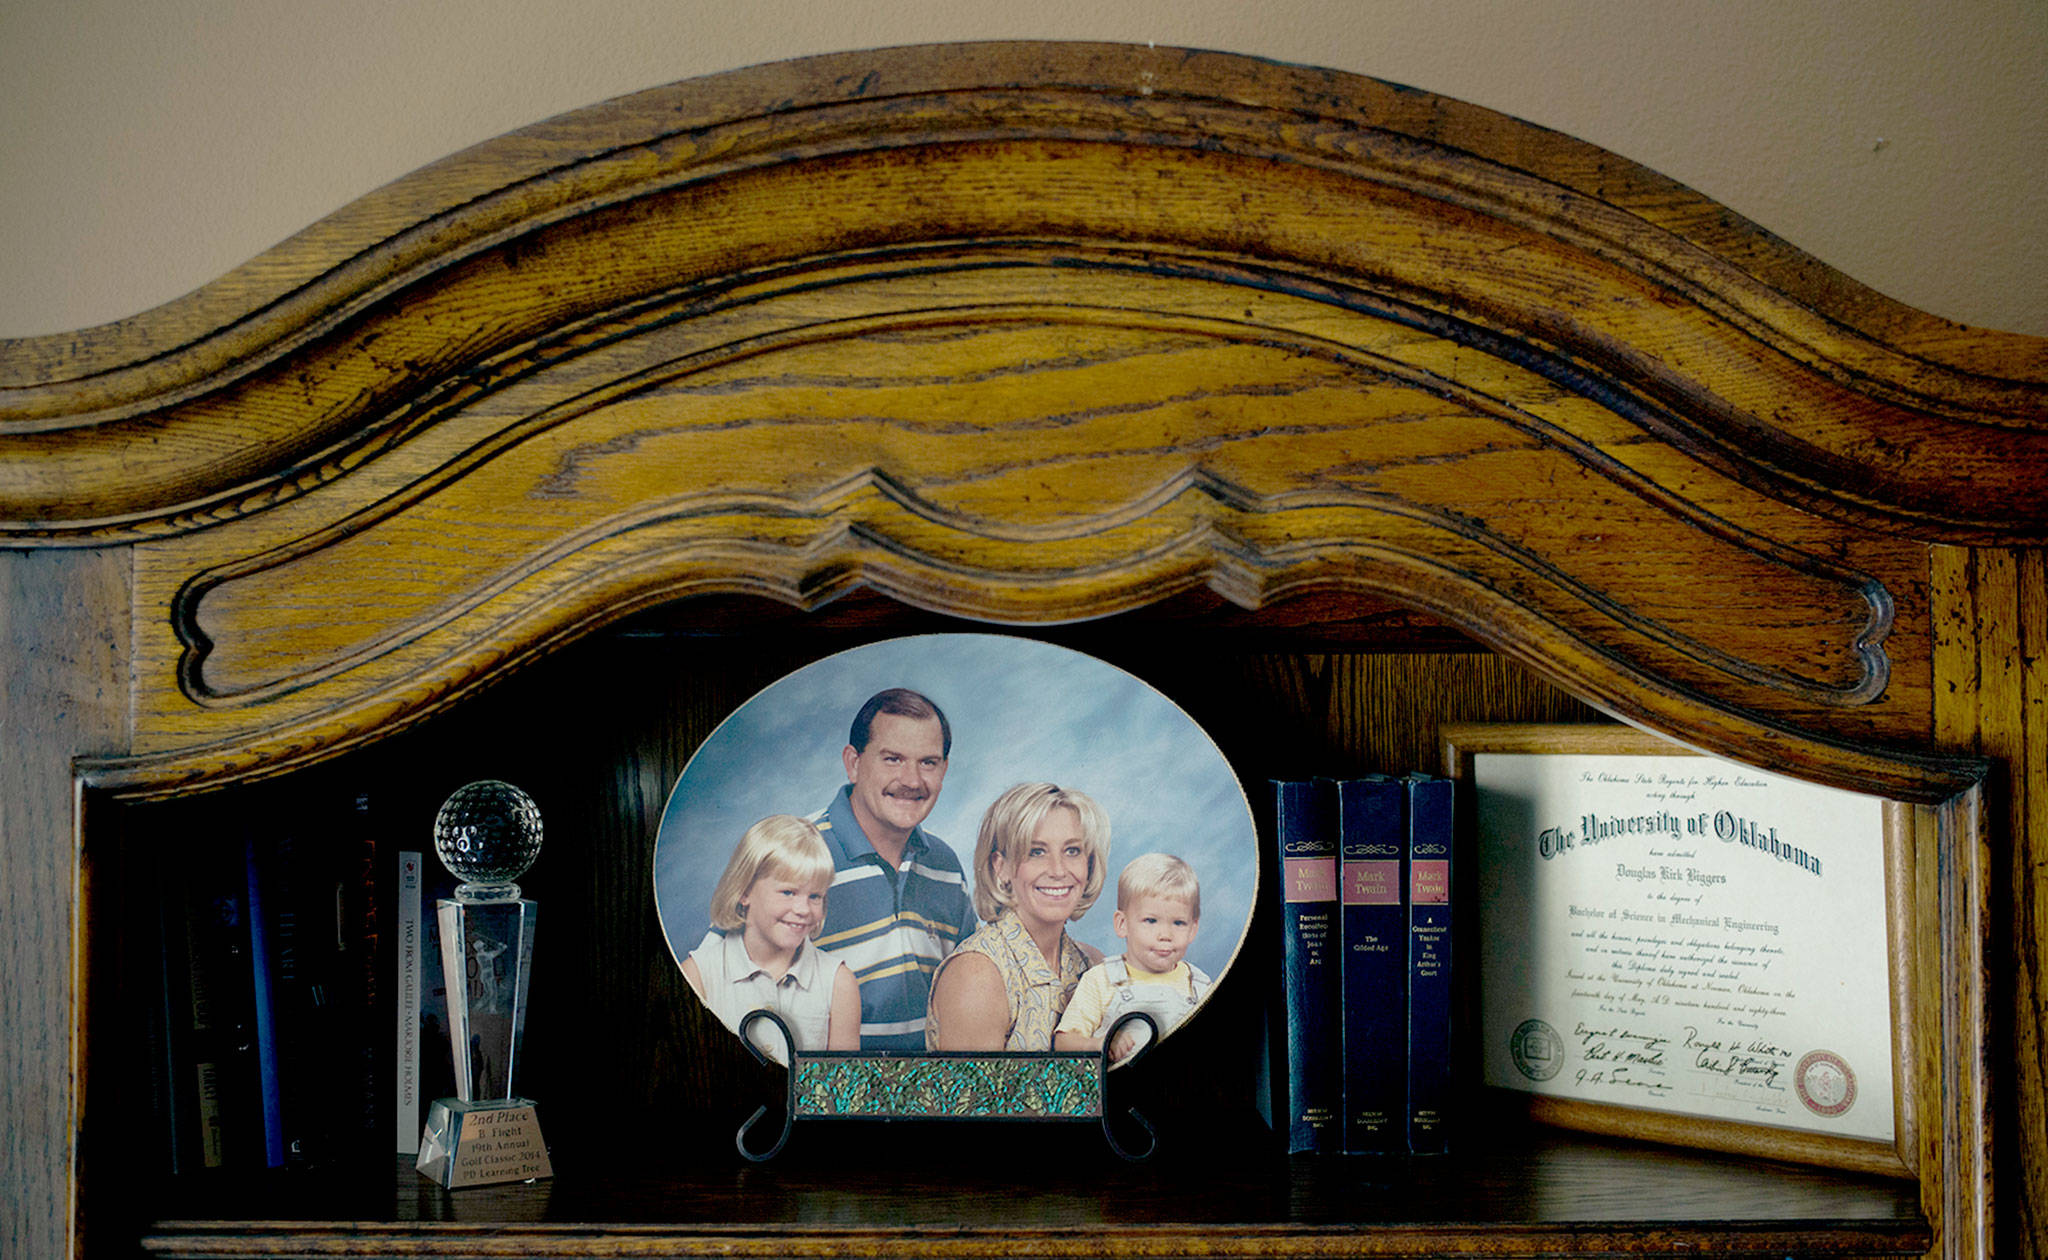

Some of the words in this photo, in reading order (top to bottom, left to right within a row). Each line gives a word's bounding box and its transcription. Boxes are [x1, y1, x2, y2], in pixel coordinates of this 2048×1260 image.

[1688, 776, 1699, 788] for
[1734, 776, 1768, 787] Education
[1669, 791, 1696, 803] through
[1538, 826, 1576, 860] The
[1580, 810, 1682, 845] University
[1687, 812, 1710, 837] of
[1714, 809, 1823, 877] Oklahoma
[1357, 871, 1385, 882] Mark
[1418, 871, 1443, 881] Mark
[1616, 863, 1657, 882] Douglas
[1660, 865, 1683, 885] Kirk
[1686, 866, 1727, 887] Biggers
[1355, 884, 1387, 895] Twain
[1416, 883, 1444, 894] Twain
[1657, 891, 1667, 900] the
[1670, 893, 1691, 906] degree
[1694, 894, 1704, 906] of
[1299, 914, 1328, 922] Personal
[1427, 917, 1433, 925] A
[1568, 904, 1605, 919] Bachelor
[1608, 909, 1616, 919] of
[1620, 908, 1654, 923] Science
[1657, 912, 1666, 923] in
[1669, 912, 1720, 928] Mechanical
[1723, 916, 1779, 936] Engineering
[405, 920, 414, 943] TWO
[1365, 935, 1379, 943] The
[1377, 944, 1389, 952] Age
[405, 945, 414, 973] FROM
[405, 975, 413, 1010] GALILEE
[404, 1015, 413, 1063] MARJORIE
[404, 1066, 412, 1106] HOLMES
[469, 1112, 493, 1126] 2nd
[497, 1110, 528, 1124] Place
[492, 1127, 522, 1137] Flight
[471, 1141, 492, 1153] 19th
[496, 1139, 529, 1151] Annual
[461, 1156, 482, 1167] Golf
[484, 1154, 516, 1165] Classic
[519, 1151, 542, 1161] 2014
[463, 1169, 477, 1179] PD
[479, 1166, 520, 1178] Learning
[522, 1164, 541, 1174] Tree
